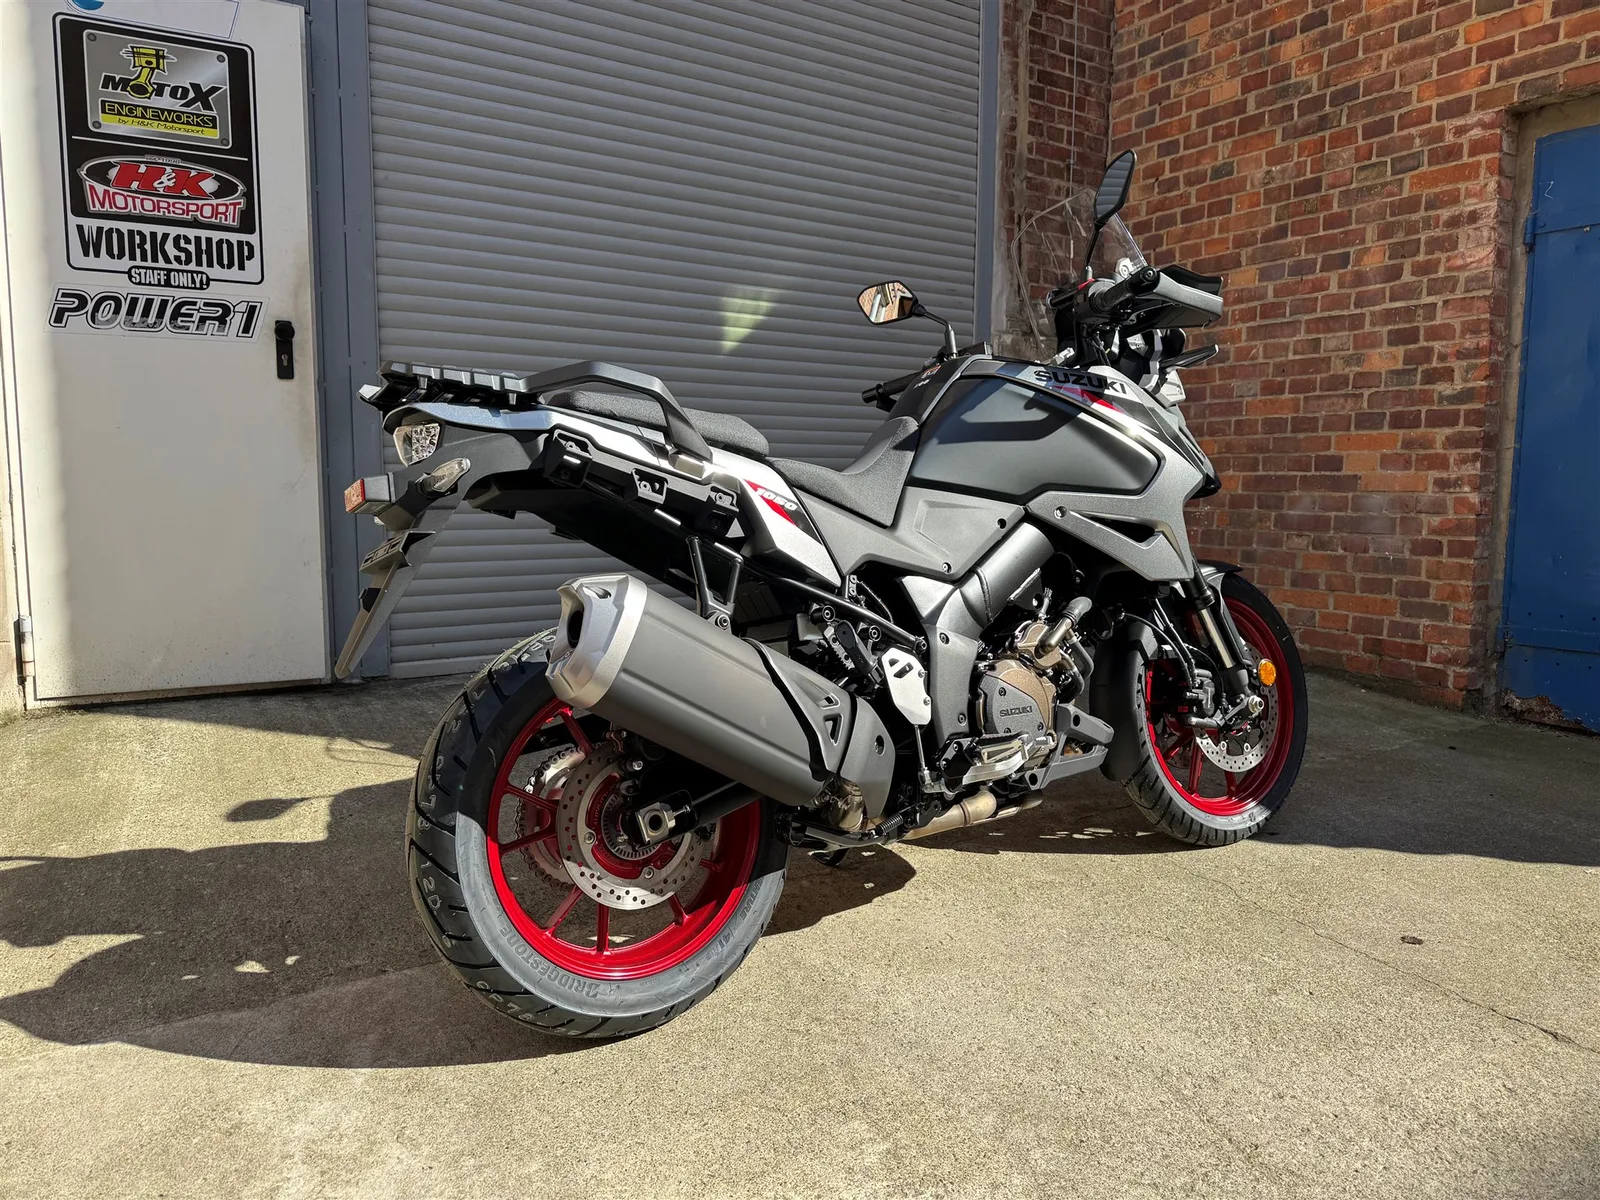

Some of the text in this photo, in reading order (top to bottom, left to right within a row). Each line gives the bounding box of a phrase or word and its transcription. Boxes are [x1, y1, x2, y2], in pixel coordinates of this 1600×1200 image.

[105, 102, 213, 127] ENGINEWORKS
[117, 117, 206, 135] by H&K Motorsport
[110, 161, 215, 198] H&K
[88, 184, 244, 225] MOTORSPORT
[76, 224, 255, 271] WORKSHOP
[131, 268, 208, 288] STAFF ONLY!
[49, 288, 263, 339] POWER1
[1034, 369, 1127, 395] SUZUKI
[756, 487, 798, 511] 1050
[1000, 705, 1033, 717] SUZUKI
[499, 926, 601, 999] BRIDGESTONE
